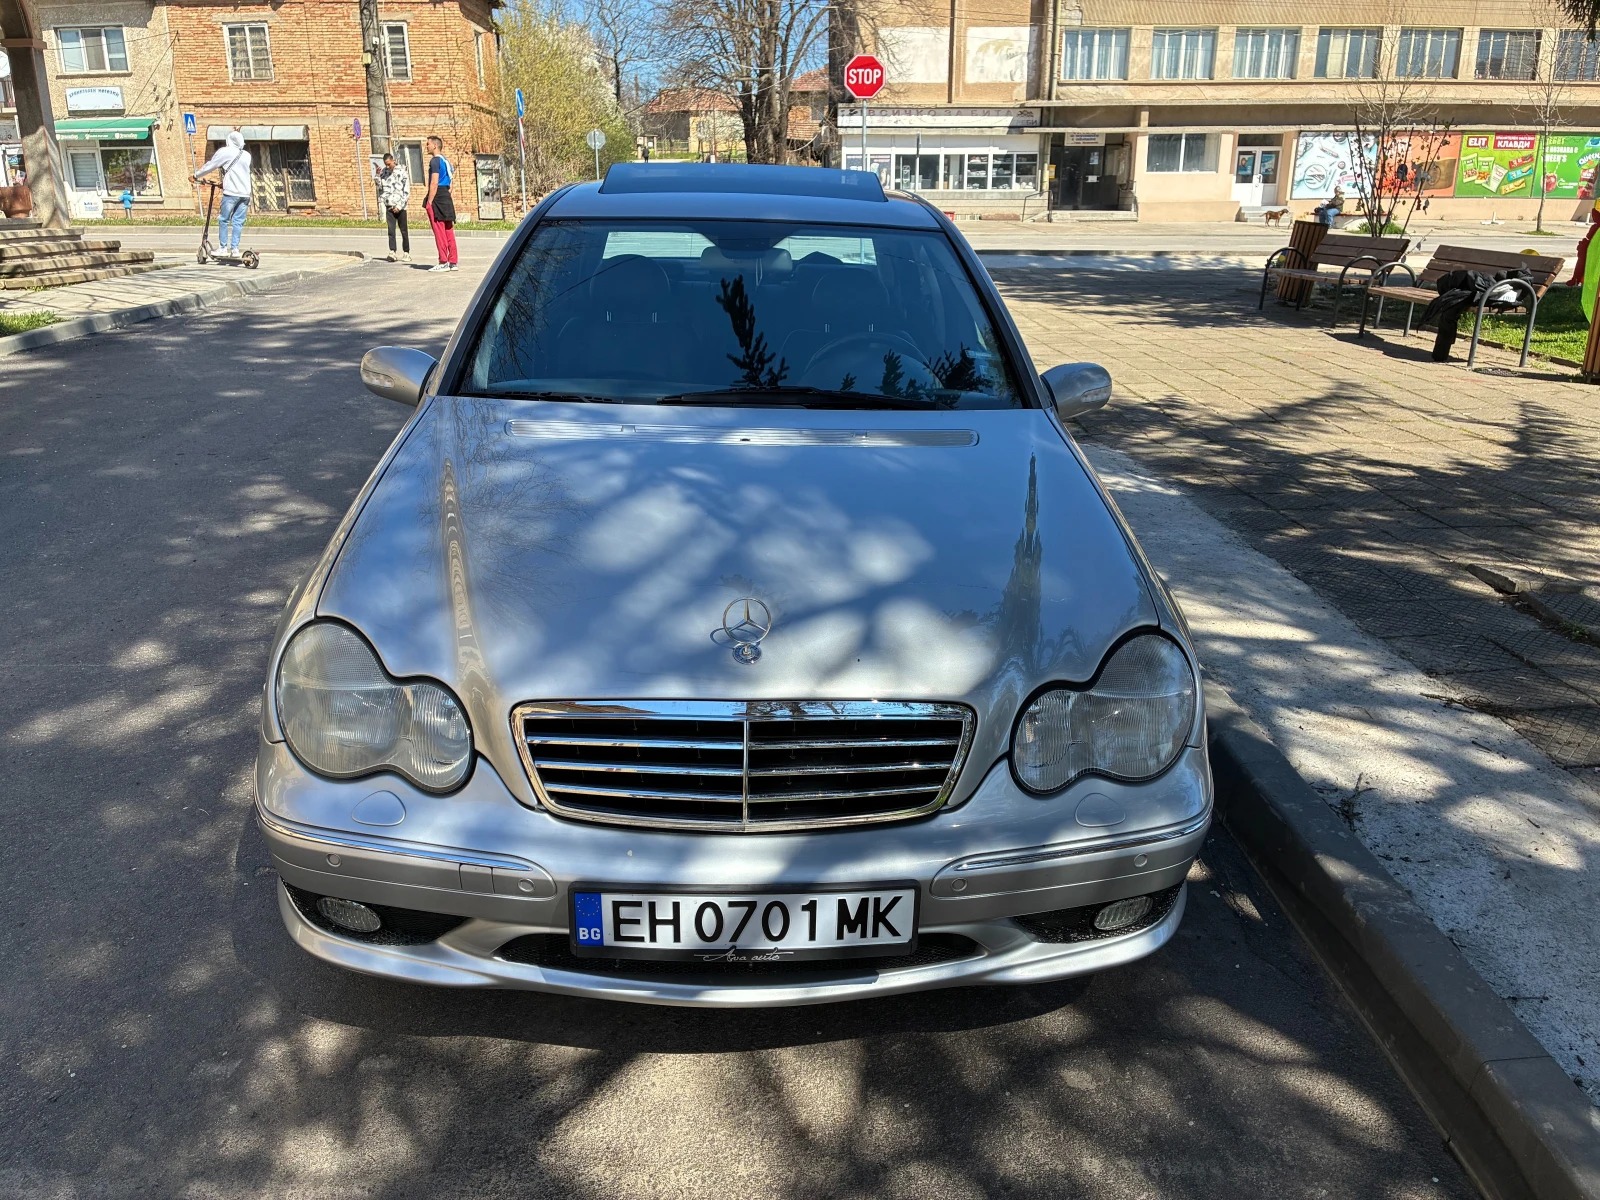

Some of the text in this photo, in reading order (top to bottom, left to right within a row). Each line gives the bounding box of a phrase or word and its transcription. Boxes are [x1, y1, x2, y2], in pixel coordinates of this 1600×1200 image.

[848, 69, 882, 85] STOP
[868, 109, 1014, 117] ВСИЧКО ЗА БИТА
[1468, 137, 1488, 147] ELIT
[1497, 140, 1530, 149] КЛАВДИ
[612, 895, 903, 943] EH 0701 MK
[578, 927, 602, 941] BG
[751, 947, 794, 961] auto
